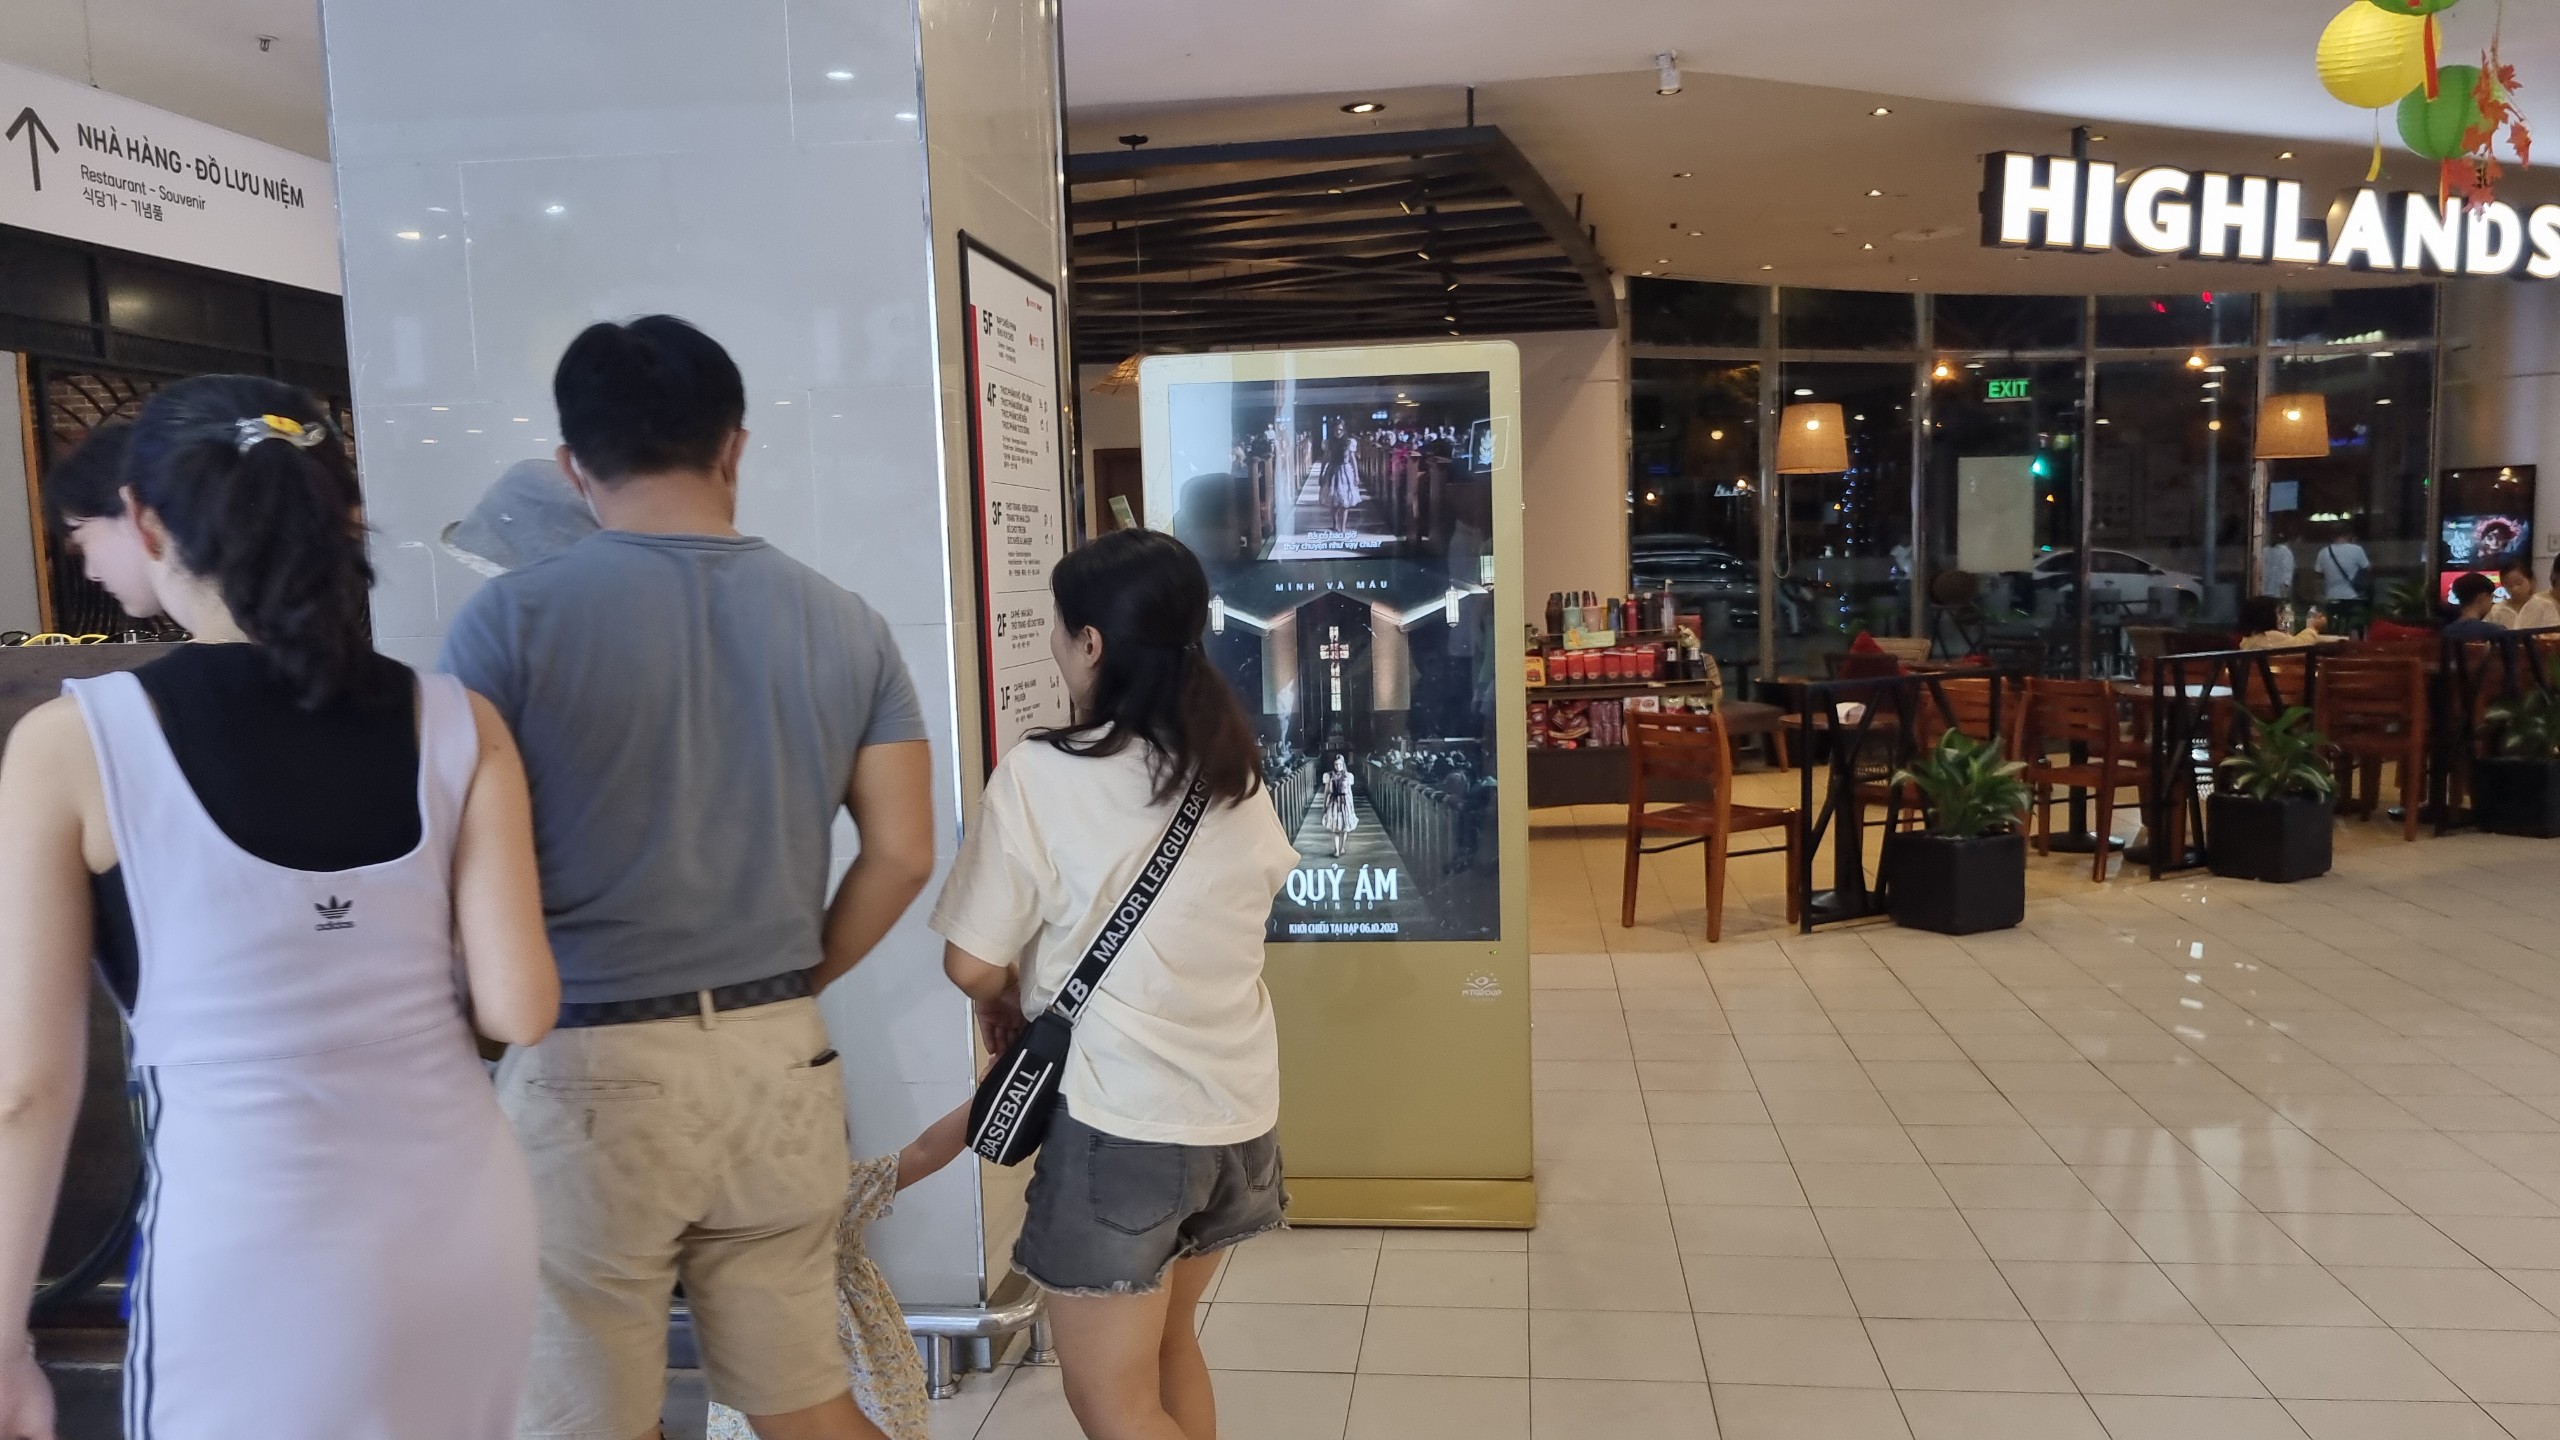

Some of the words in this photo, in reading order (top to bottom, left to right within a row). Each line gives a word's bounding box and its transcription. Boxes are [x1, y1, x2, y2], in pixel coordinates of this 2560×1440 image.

[77, 123, 123, 158] NHÀ
[126, 135, 182, 173] HÀNG
[195, 154, 221, 185] ĐỒ
[225, 166, 259, 196] LƯU
[263, 177, 304, 209] NIỆM
[80, 164, 147, 196] Restaurant
[159, 185, 206, 211] Souvenir
[82, 187, 118, 212] 식당가
[131, 199, 163, 222] 기념품
[2001, 153, 2560, 279] HIGHLANDS
[982, 310, 993, 336] 5F
[987, 382, 997, 408] 4F
[1988, 380, 2029, 398] EXIT
[992, 501, 1002, 527] 3F
[997, 613, 1007, 637] 2F
[1001, 686, 1010, 712] 1F
[1092, 892, 1149, 963] MAJOR
[1139, 817, 1192, 894] LEAGUE
[1286, 863, 1345, 906] QUỶ
[1360, 922, 1398, 934] 06.10.2023
[980, 1070, 1040, 1157] BASEBALL
